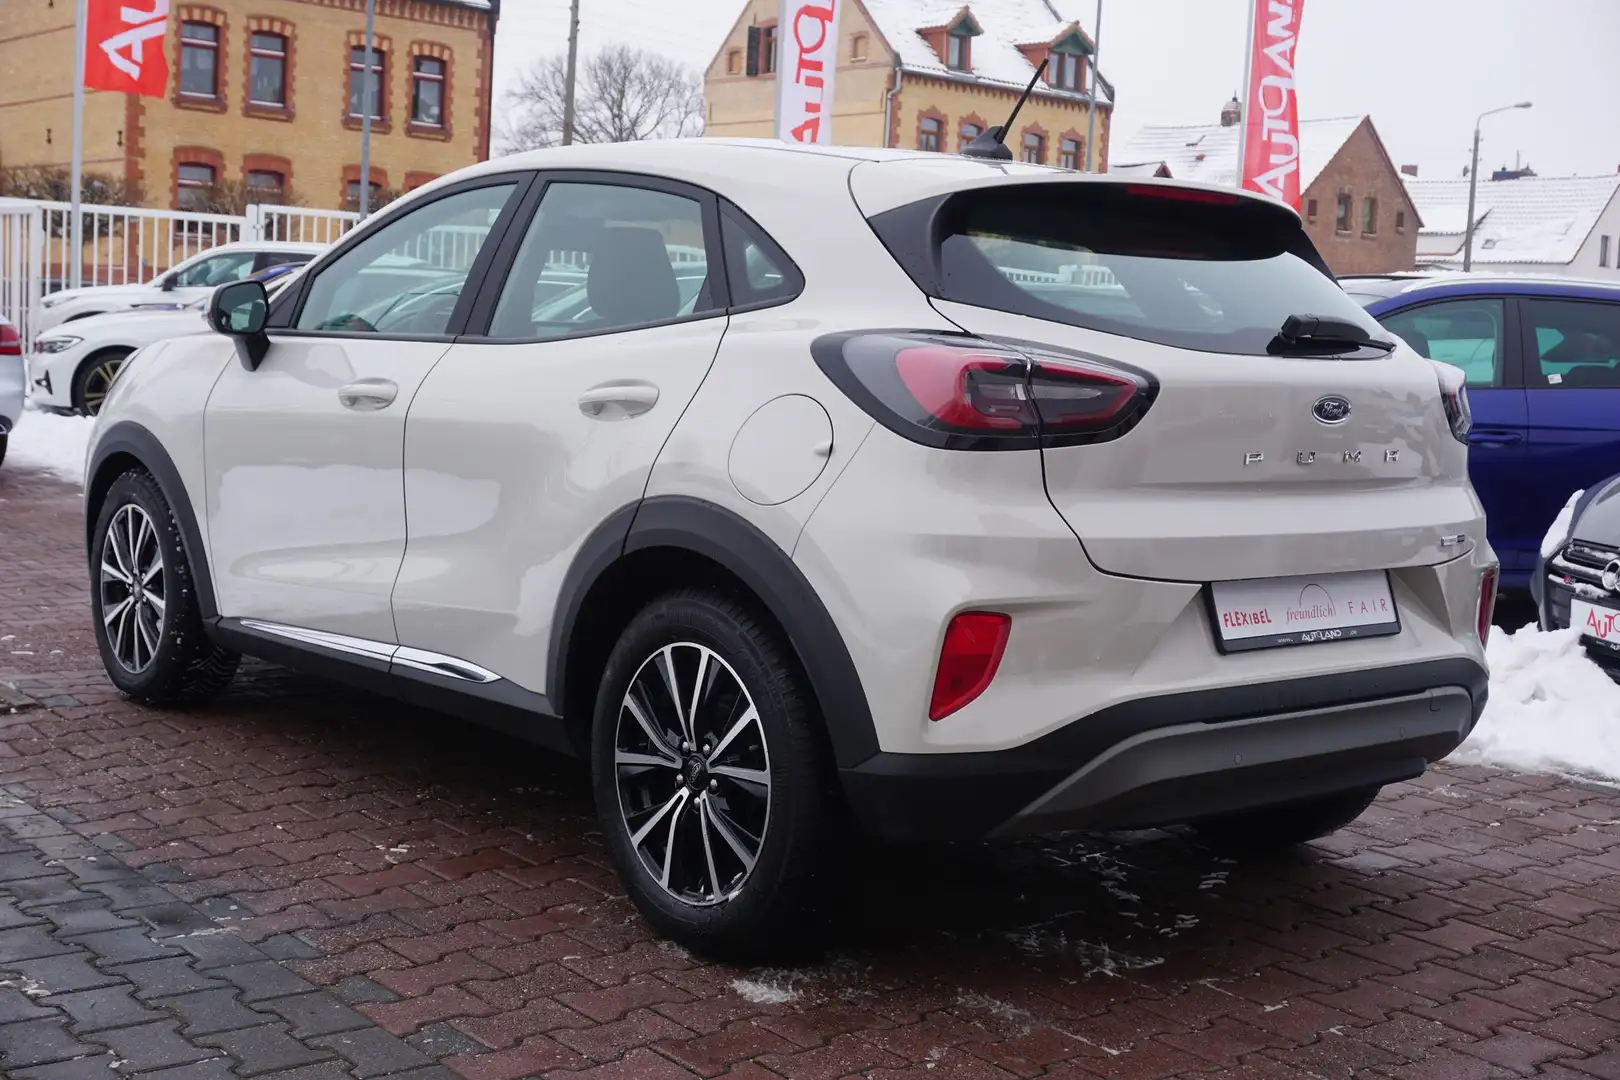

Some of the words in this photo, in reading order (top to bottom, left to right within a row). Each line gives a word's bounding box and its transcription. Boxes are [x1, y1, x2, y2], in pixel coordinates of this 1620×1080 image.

[1321, 401, 1344, 418] Ford
[1244, 449, 1400, 466] PUMA
[1223, 608, 1272, 628] FLEXIBEL
[1286, 603, 1336, 624] freundlich
[1348, 598, 1388, 615] FAIR
[1301, 629, 1342, 643] AUTOLAND
